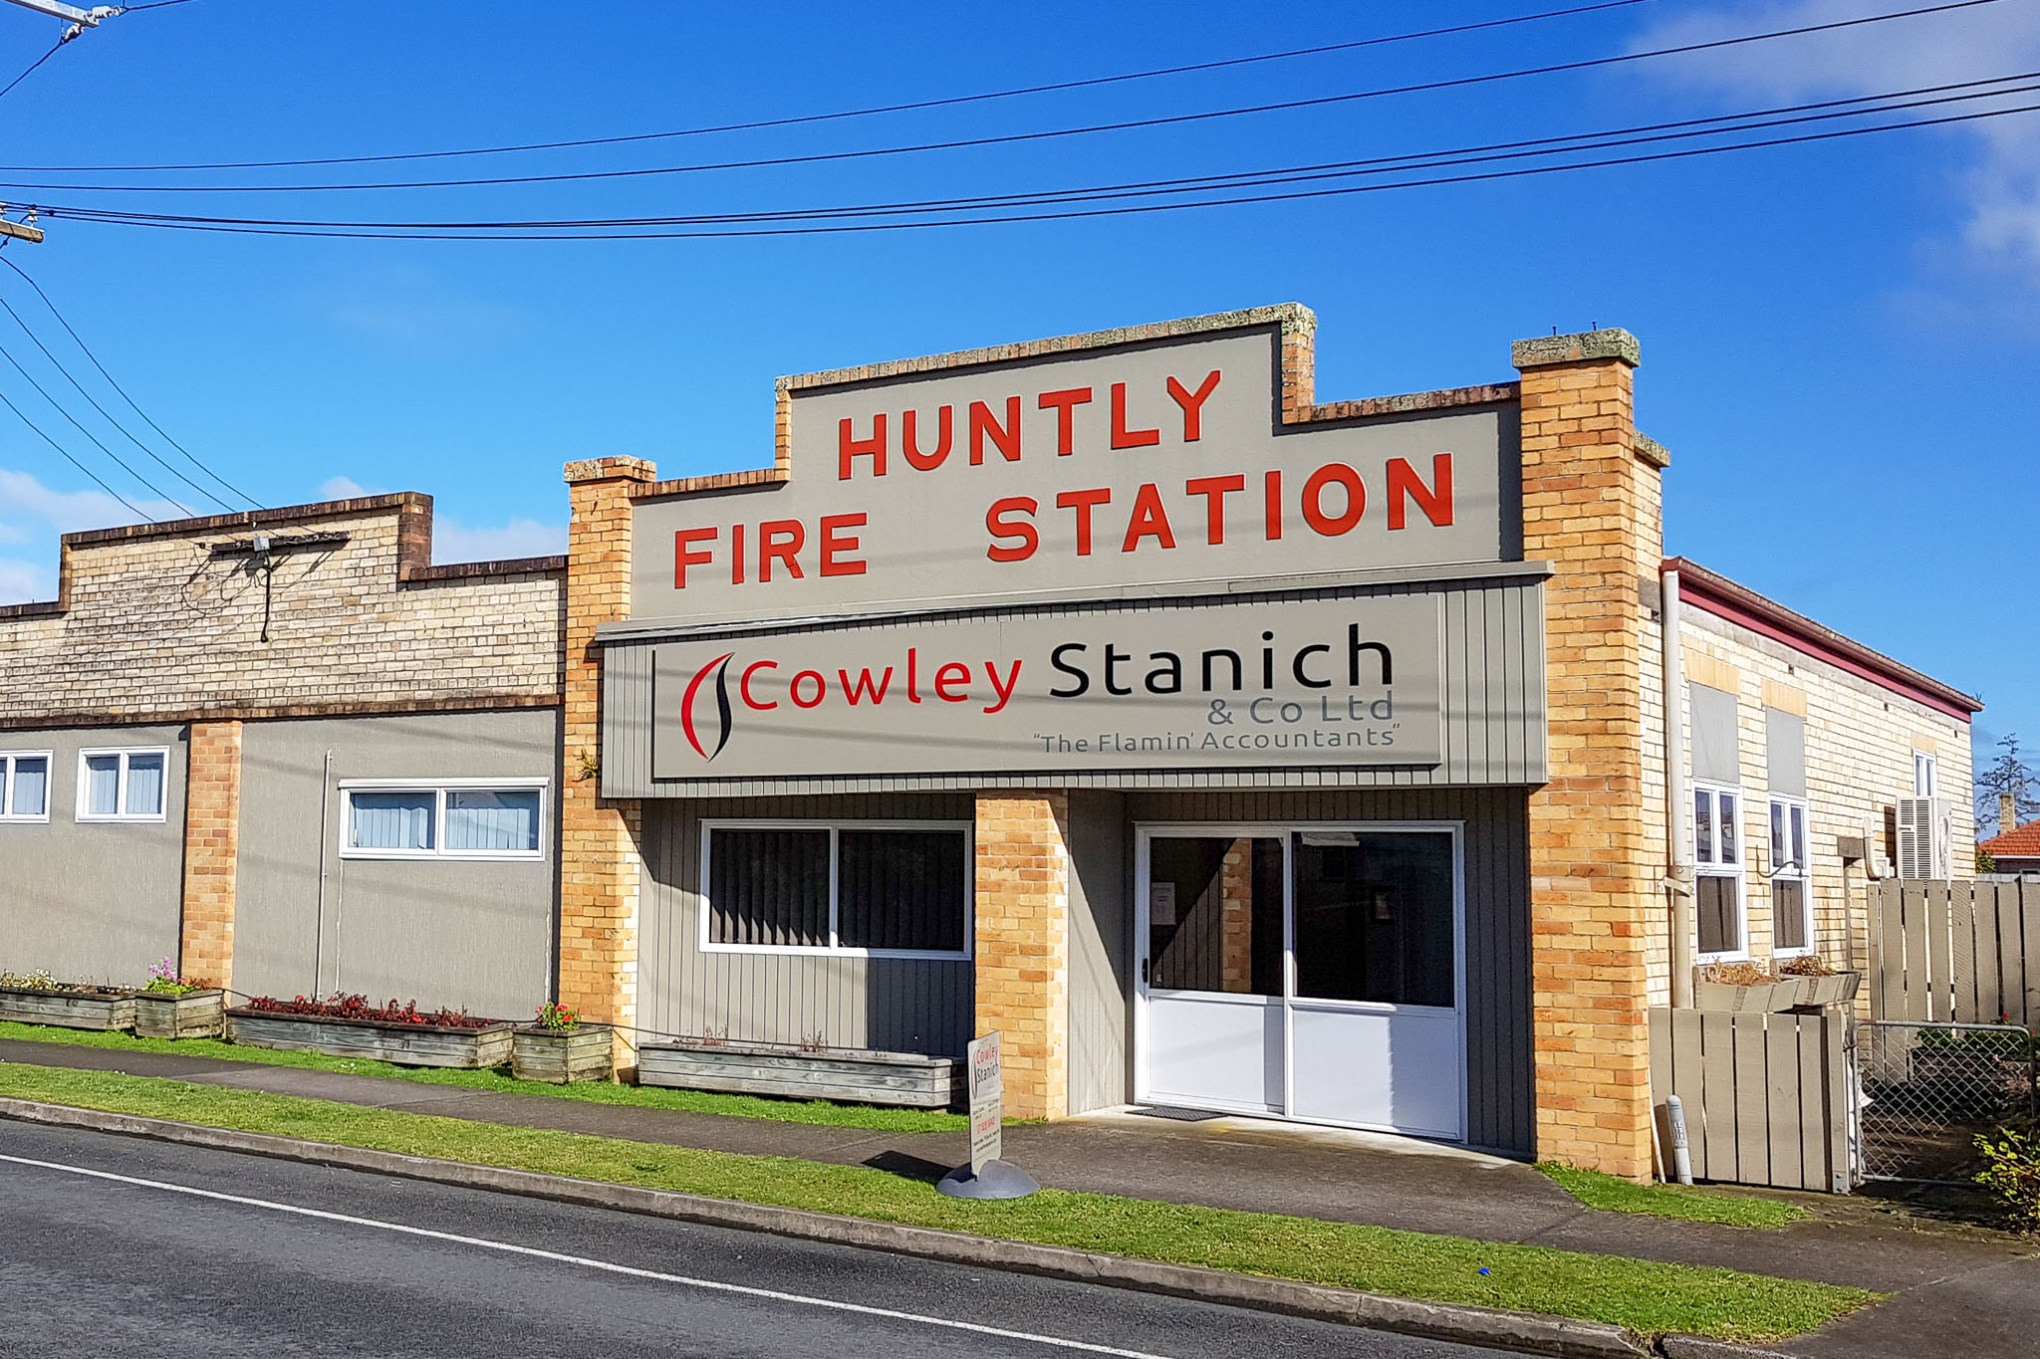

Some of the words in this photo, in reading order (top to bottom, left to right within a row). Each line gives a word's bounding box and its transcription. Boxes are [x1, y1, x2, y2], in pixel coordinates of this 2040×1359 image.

[839, 369, 1221, 481] HUNTLY
[674, 512, 868, 589] FIRE
[986, 452, 1454, 562] STATION
[740, 646, 1023, 715] Cowley
[1050, 622, 1393, 699] Stanich
[1207, 698, 1234, 725] &
[1250, 697, 1302, 725] Co
[1321, 690, 1393, 722] Ltd
